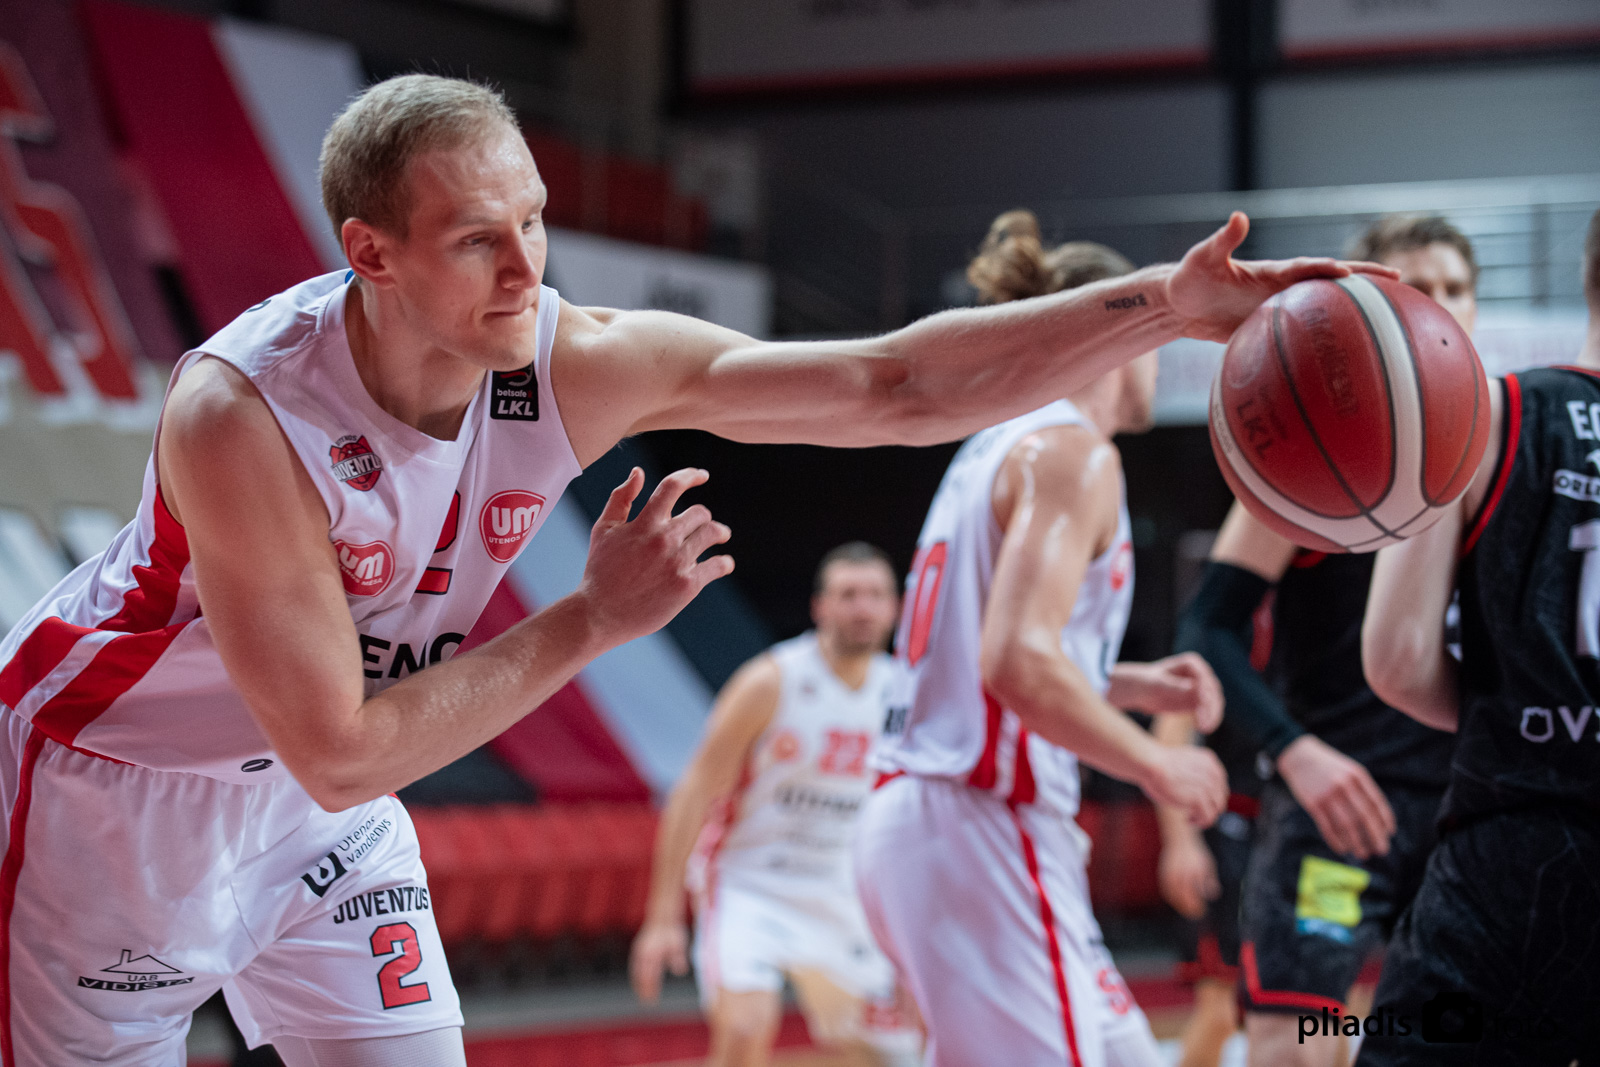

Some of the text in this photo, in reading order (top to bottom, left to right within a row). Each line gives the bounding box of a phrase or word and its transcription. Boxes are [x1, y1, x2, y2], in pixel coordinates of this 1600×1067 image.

[497, 389, 527, 397] betsafe
[497, 400, 534, 417] LKL
[488, 534, 521, 545] UTENOS
[337, 815, 377, 852] Utenos
[346, 818, 392, 864] vandenys
[333, 886, 429, 925] JUVENTUS
[369, 921, 433, 1010] 2
[79, 977, 194, 991] VIDISTA
[127, 974, 159, 982] UAB
